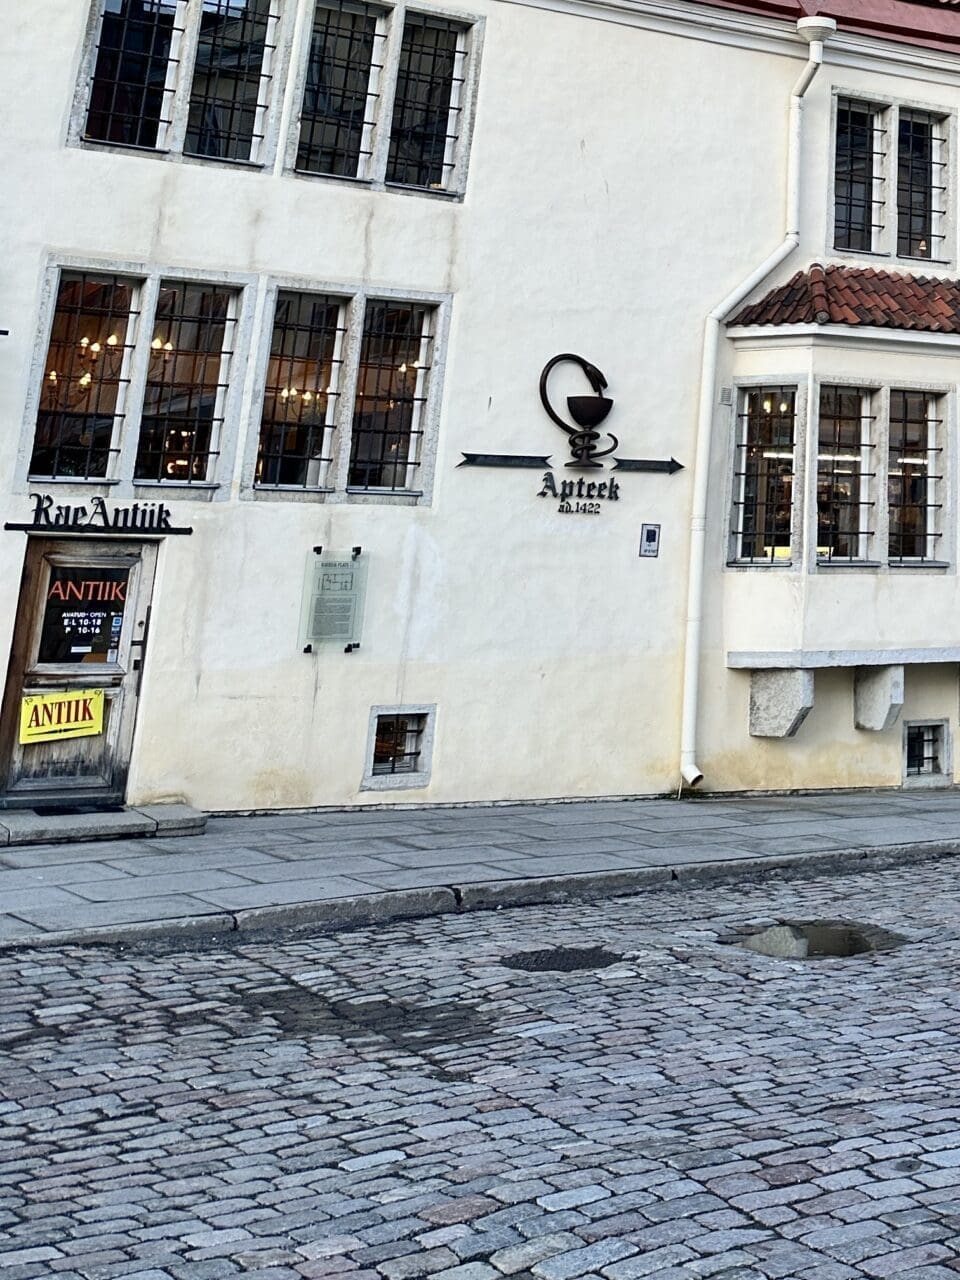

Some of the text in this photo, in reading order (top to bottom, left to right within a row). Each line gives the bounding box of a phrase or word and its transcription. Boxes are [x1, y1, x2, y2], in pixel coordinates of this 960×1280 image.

[537, 472, 620, 503] Apteek
[48, 580, 127, 601] ANTIIK
[65, 626, 71, 634] P
[28, 697, 95, 729] ANTIIK
